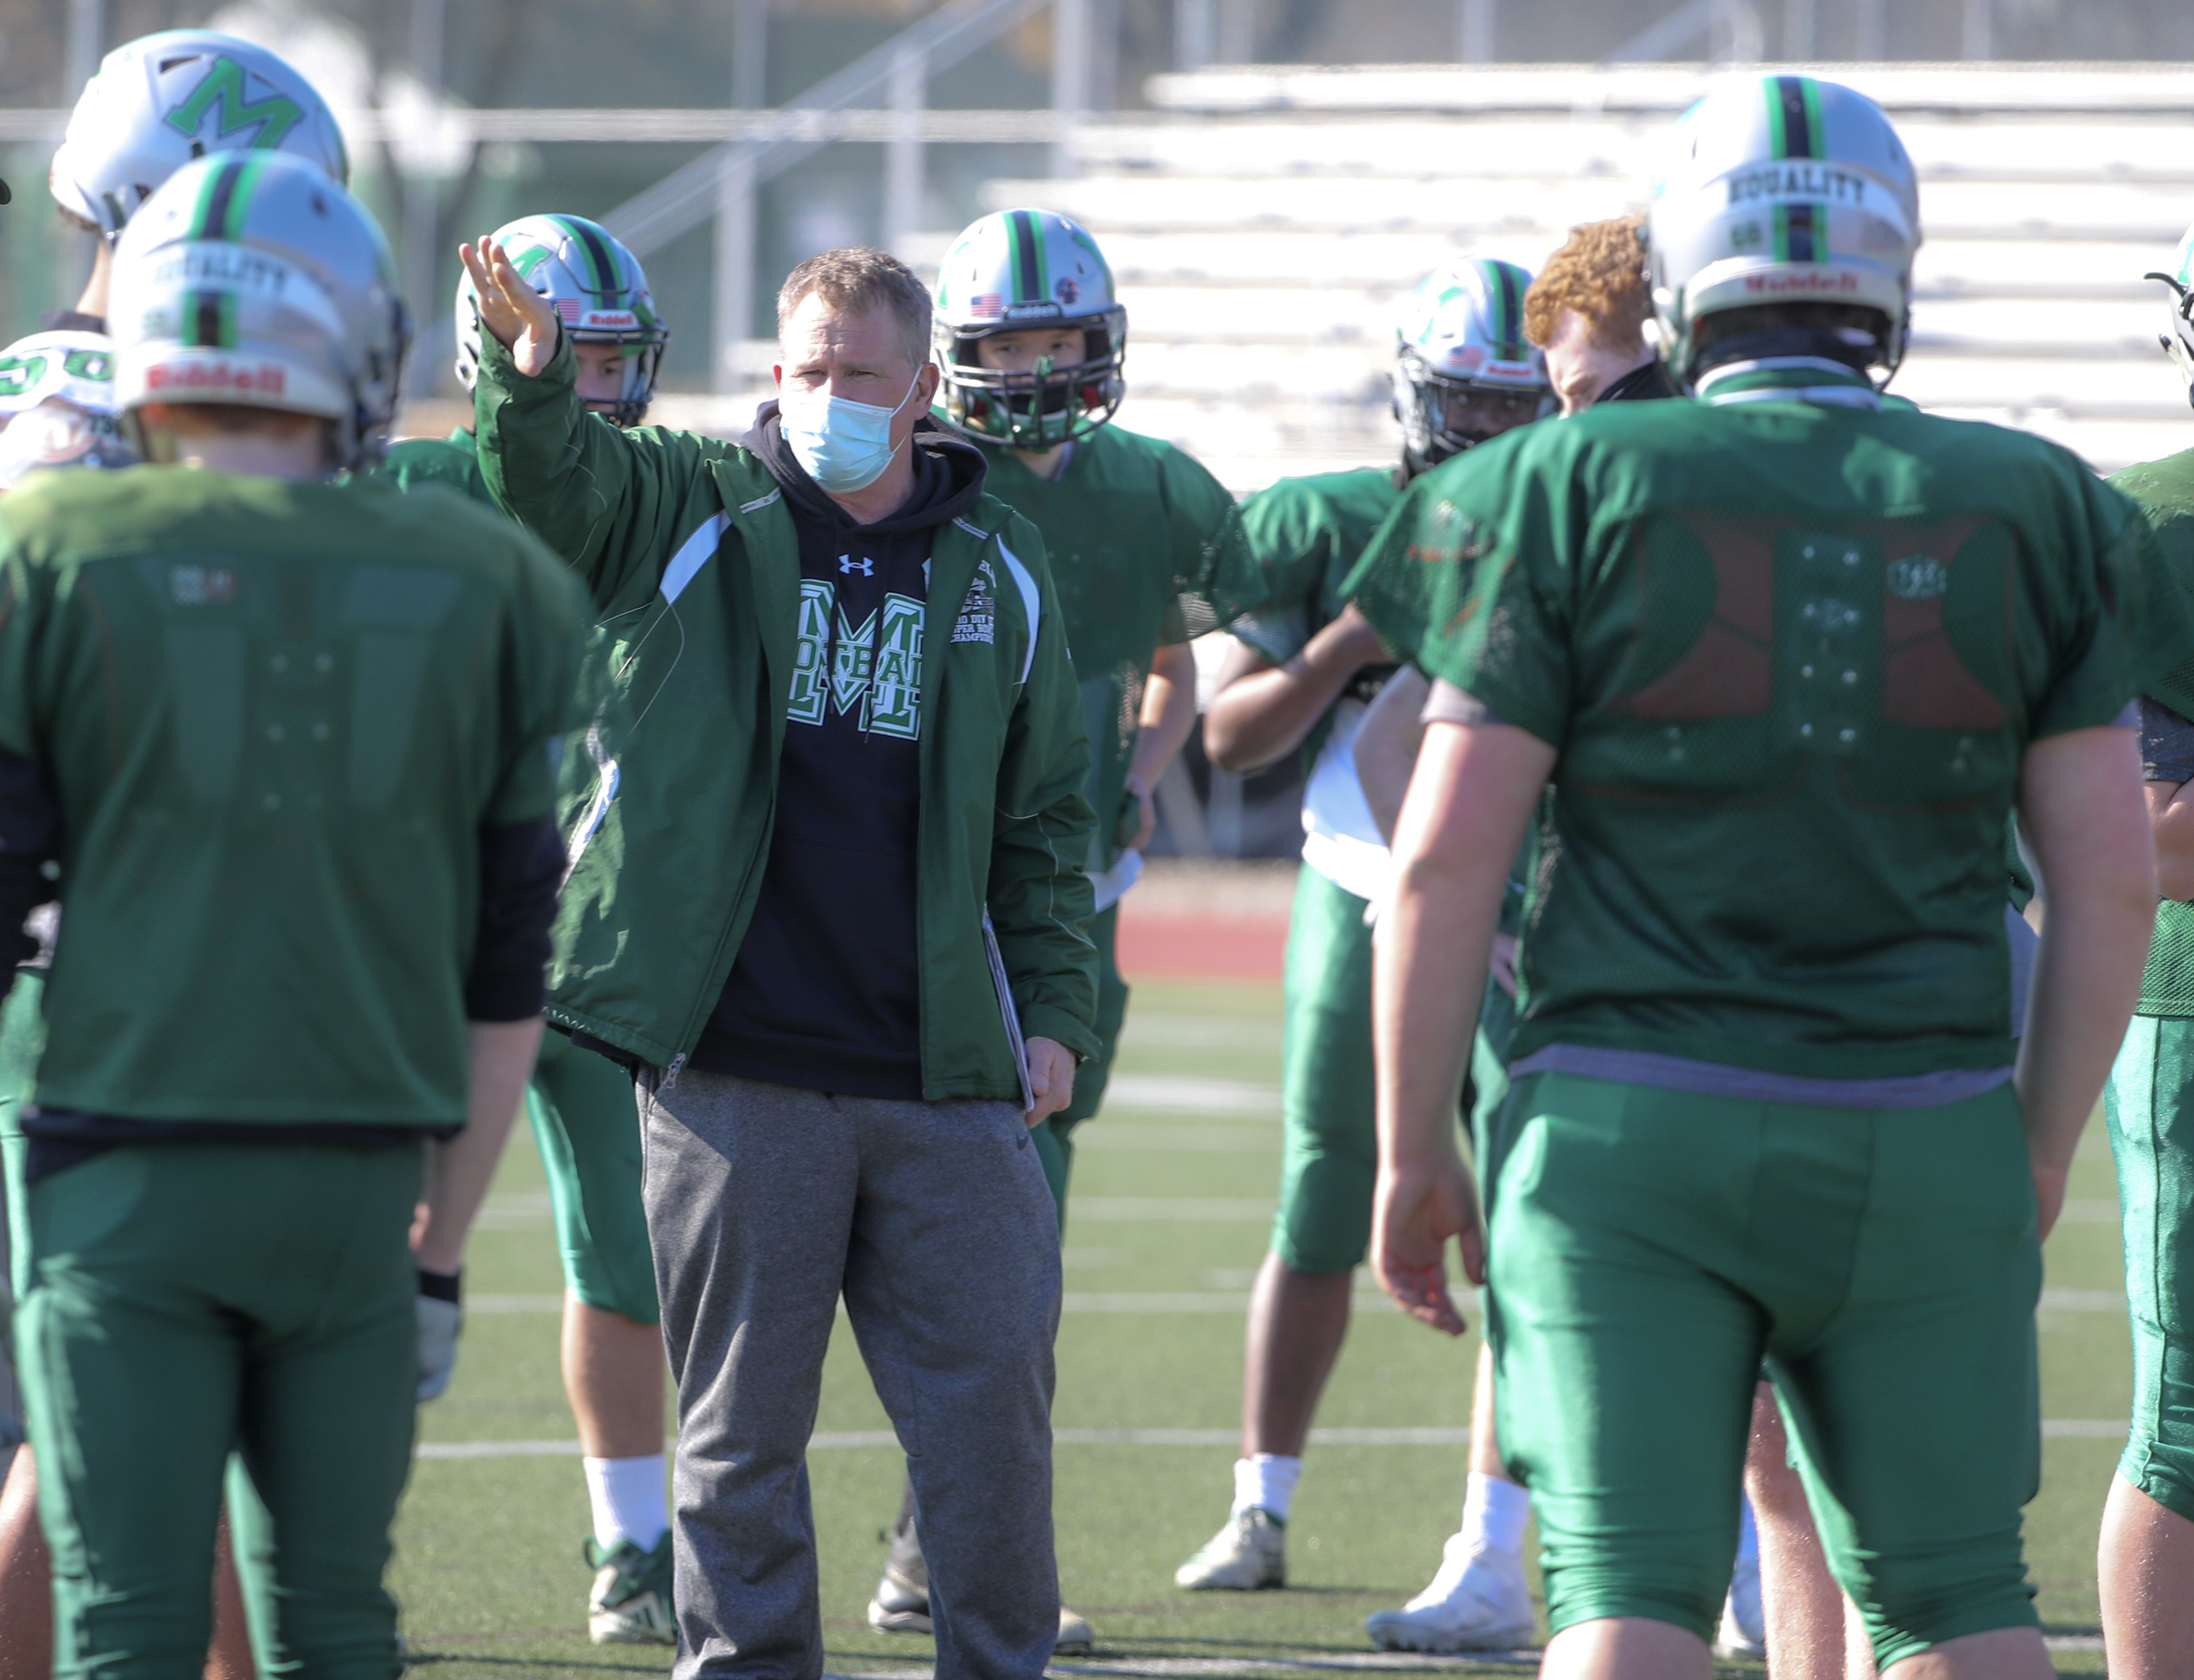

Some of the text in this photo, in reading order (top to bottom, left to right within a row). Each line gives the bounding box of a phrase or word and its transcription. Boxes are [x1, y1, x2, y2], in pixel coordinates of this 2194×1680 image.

[164, 54, 306, 148] M
[1729, 165, 1866, 204] EQUALITY
[1745, 272, 1858, 293] Riddell
[590, 313, 633, 324] Riddell
[145, 361, 285, 396] Riddell
[787, 579, 926, 741] M
